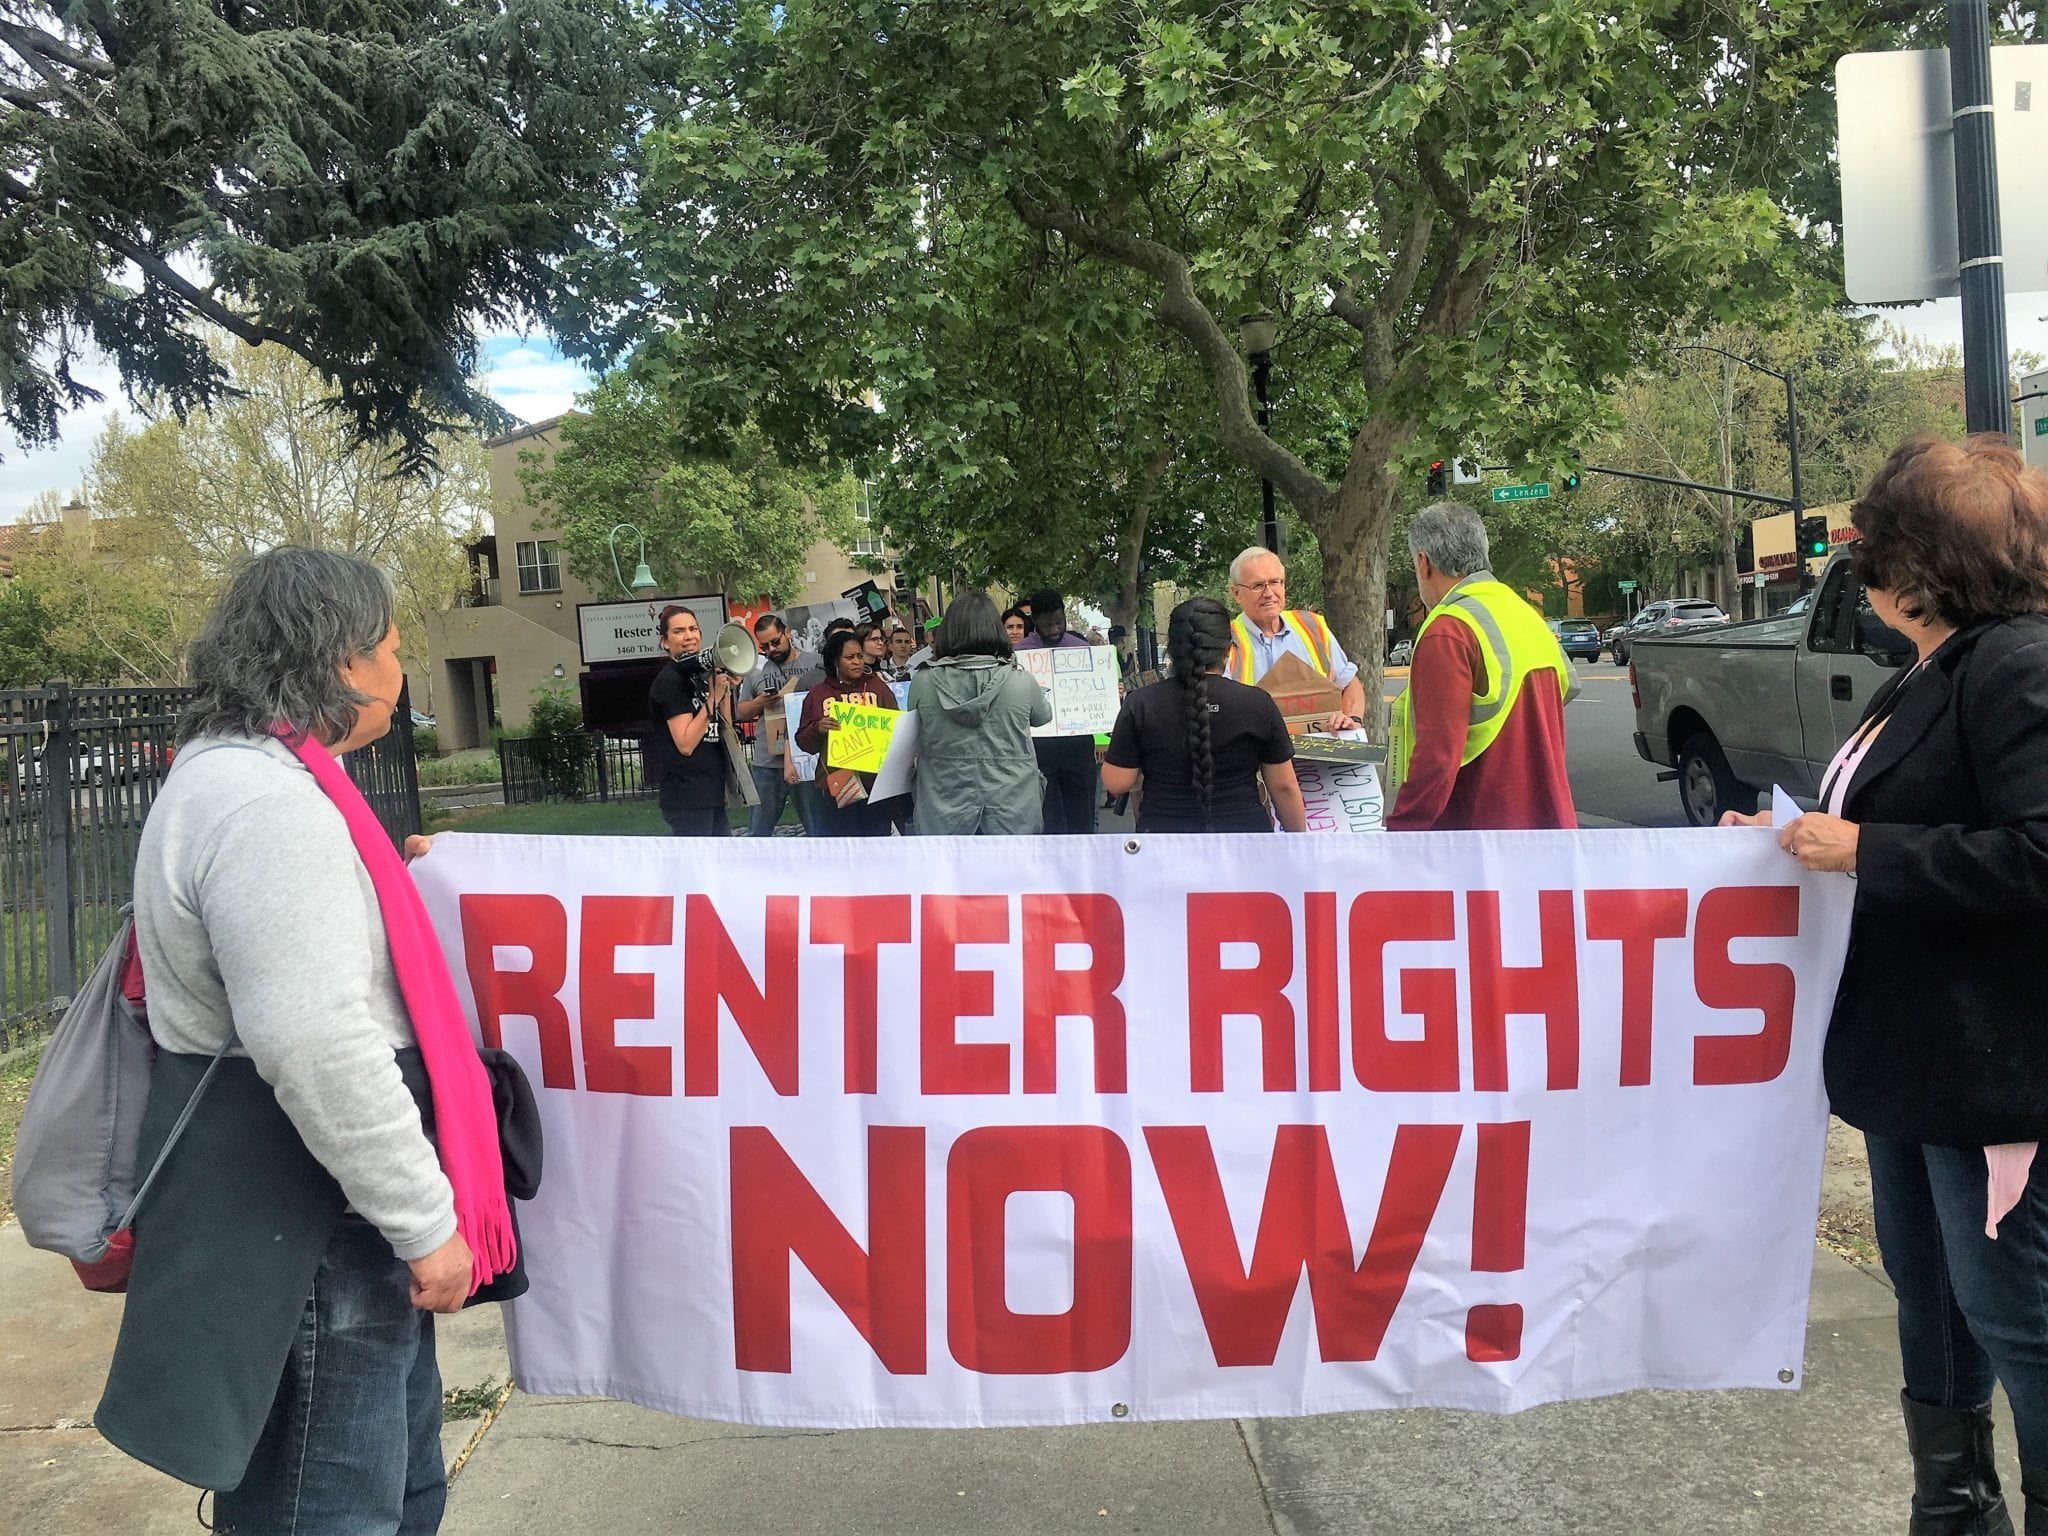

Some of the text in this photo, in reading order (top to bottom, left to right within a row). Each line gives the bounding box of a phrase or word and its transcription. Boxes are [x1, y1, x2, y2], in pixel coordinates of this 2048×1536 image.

[1514, 488, 1544, 497] Lenzen
[614, 627, 651, 639] Hester
[617, 646, 636, 655] 1460
[637, 645, 654, 653] The
[1055, 649, 1091, 669] 20%
[834, 705, 893, 733] WORK
[1296, 764, 1339, 832] ENT CON
[1339, 794, 1382, 832] JUST
[459, 886, 1800, 1096] RENTER RIGHTS
[730, 1121, 1531, 1374] NOW!
